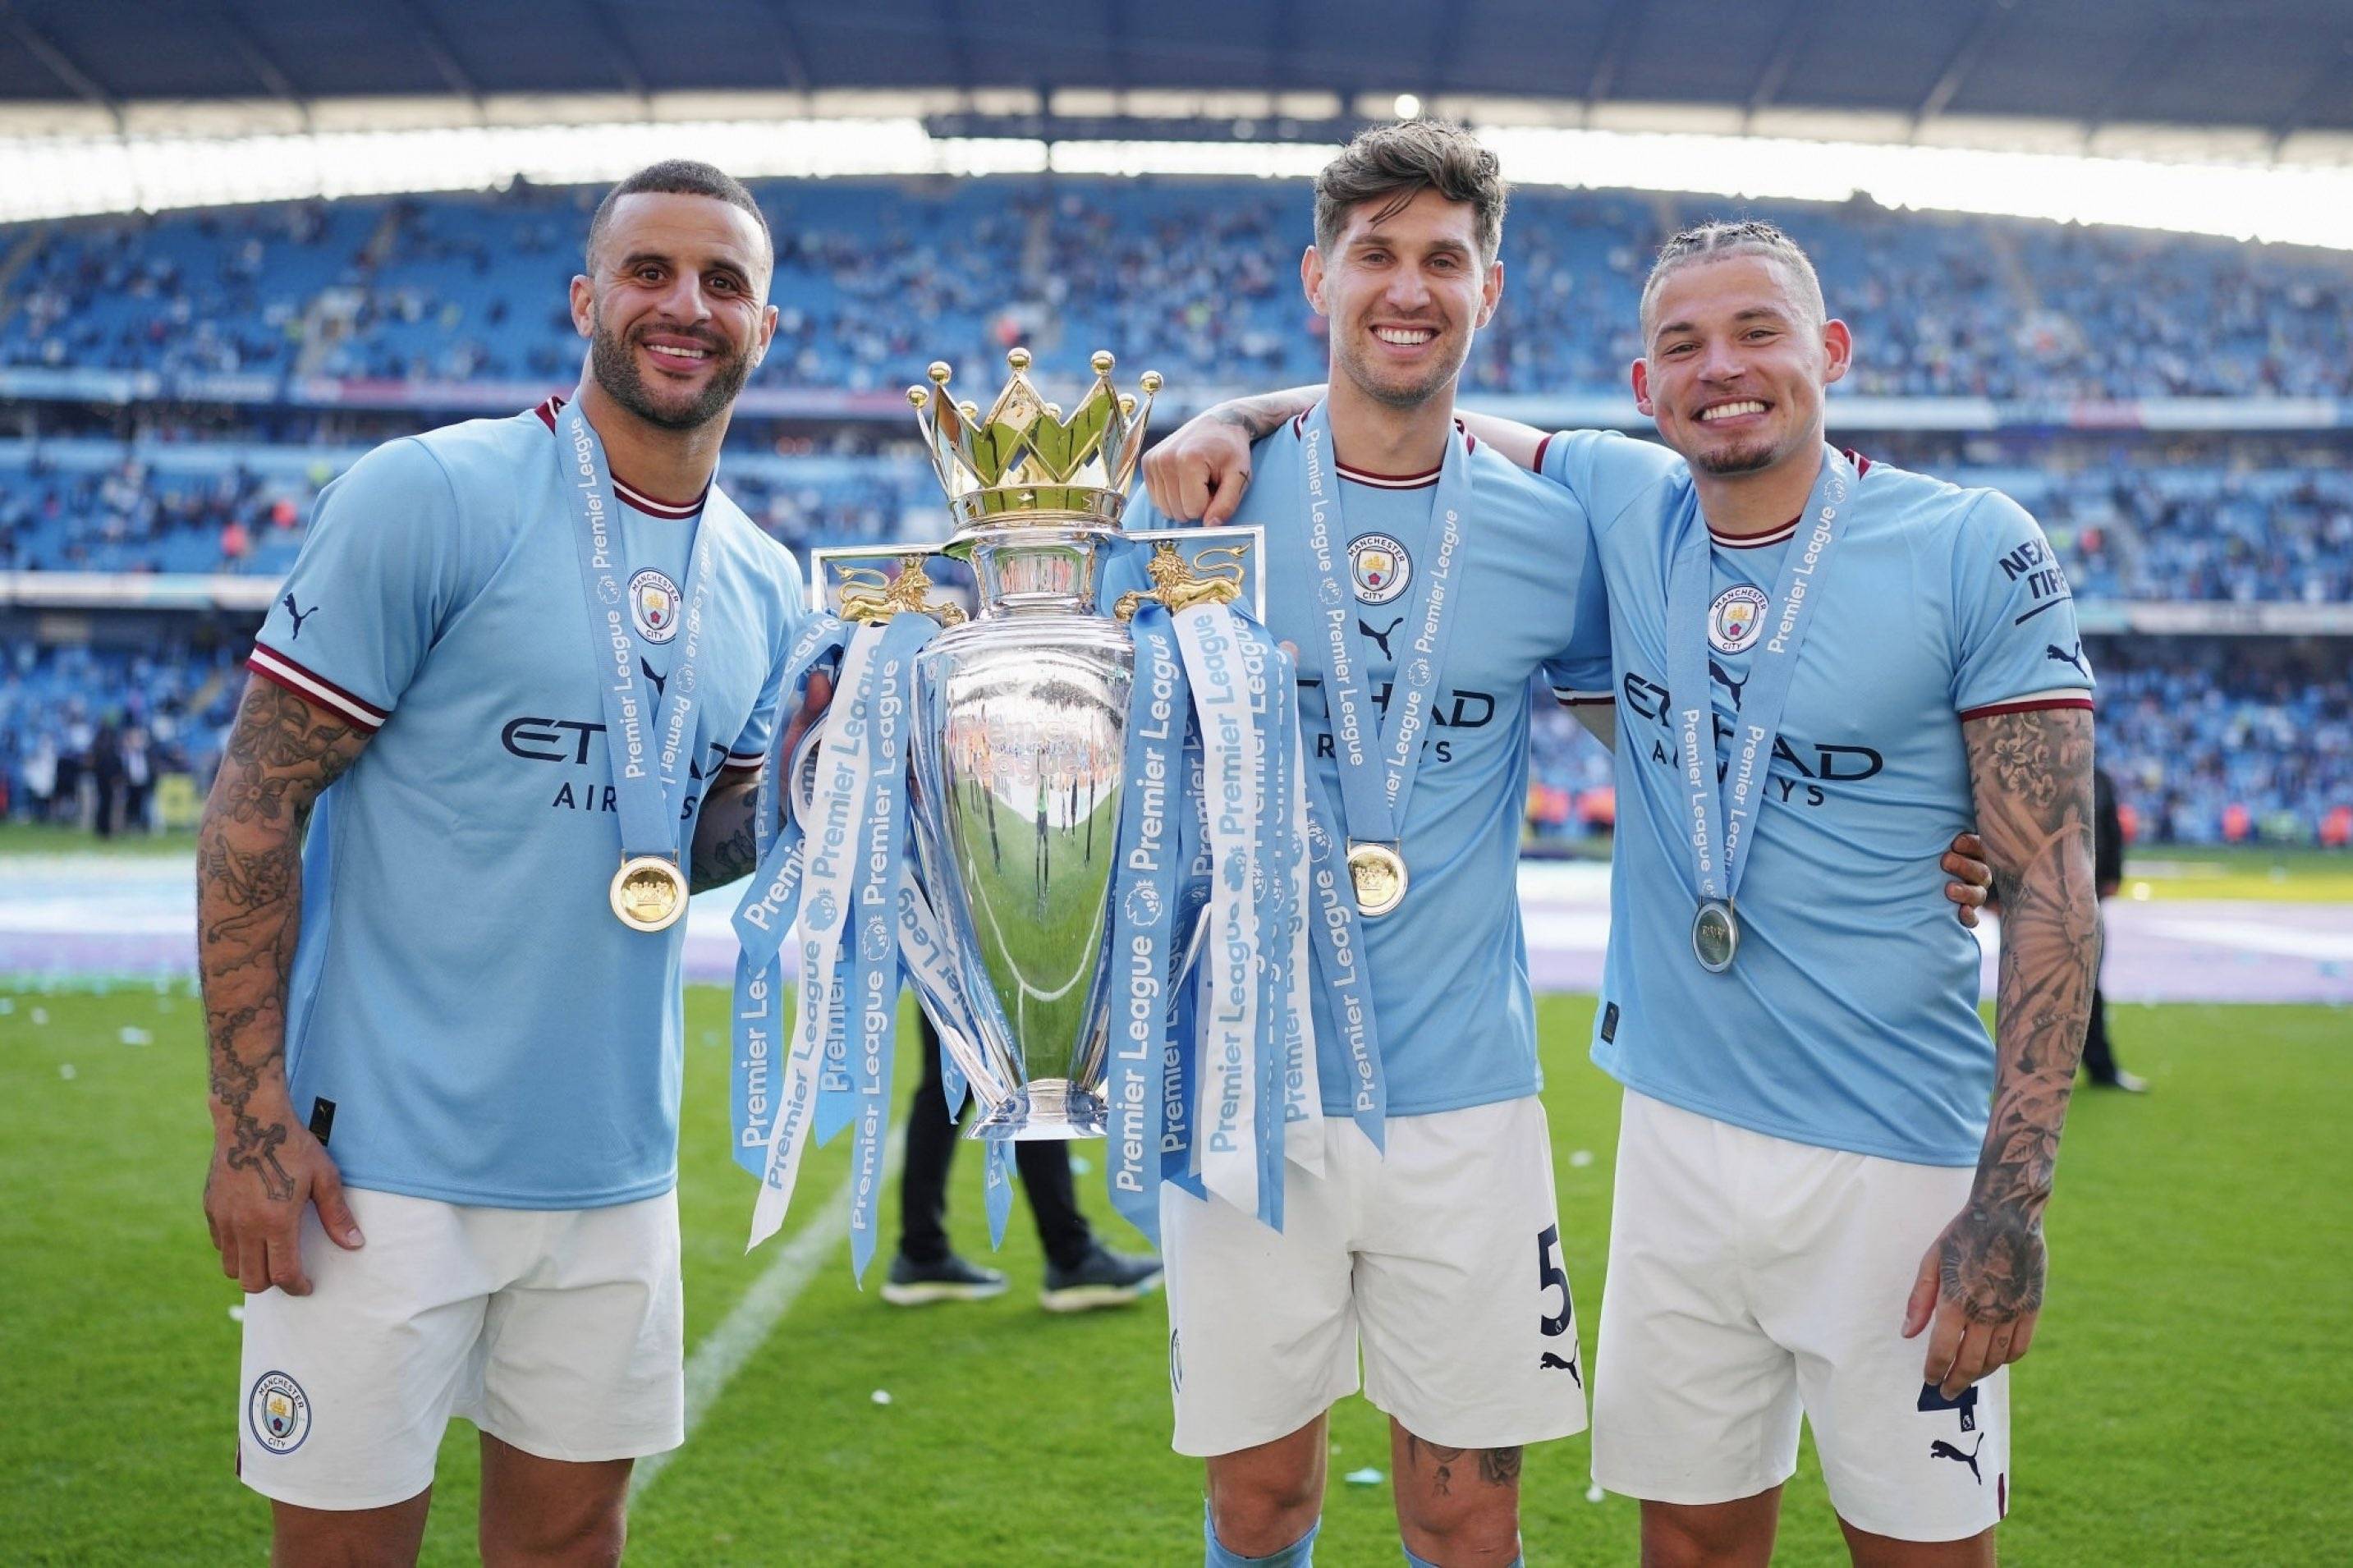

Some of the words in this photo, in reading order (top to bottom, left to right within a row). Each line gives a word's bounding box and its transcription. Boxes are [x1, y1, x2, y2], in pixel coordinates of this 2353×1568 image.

[571, 417, 597, 488] League
[1306, 429, 1323, 498] Premier
[585, 492, 608, 570] Premier
[1311, 500, 1332, 571] League
[1348, 538, 1405, 562] MANCHESTER
[1415, 580, 1445, 653] Premier
[1439, 509, 1458, 579] League
[1768, 582, 1807, 653] Premier
[1794, 505, 1836, 585] League
[1999, 538, 2054, 581] NEX
[632, 574, 679, 602] MANCHESTER
[646, 630, 663, 640] CITY
[686, 584, 709, 658] League
[1715, 589, 1767, 610] MANCHESTER
[609, 611, 632, 691] League
[785, 617, 841, 673] ague
[1140, 634, 1179, 740] League
[1194, 614, 1233, 706] League
[1325, 609, 1351, 685] Premier
[1340, 689, 1362, 766] League
[620, 695, 646, 779] Premier
[660, 696, 690, 773] Premier
[874, 659, 901, 776] League
[1397, 691, 1421, 767] League
[1682, 708, 1704, 788] Premier
[1735, 725, 1764, 805] Premier
[812, 762, 855, 880] Premier
[1129, 748, 1165, 870] Premier
[1216, 713, 1245, 836] Premier
[863, 785, 892, 905] Premier
[1691, 792, 1710, 873] League
[1219, 902, 1250, 1023] League
[1317, 869, 1357, 988] League
[862, 970, 888, 1095] League
[1118, 935, 1158, 1060] League
[741, 1028, 768, 1148] Premier
[768, 1068, 809, 1190] Premier
[793, 939, 821, 1061] League
[1161, 1038, 1187, 1153] Premier
[1210, 1034, 1241, 1152] Premier
[1285, 1007, 1310, 1124] Premier
[1344, 995, 1375, 1112] Premier
[852, 1103, 881, 1230] Premier
[1117, 1070, 1146, 1192] Premier
[1538, 1222, 1571, 1336] 5
[259, 1378, 304, 1409] MANCHESTER
[268, 1438, 286, 1448] CITY
